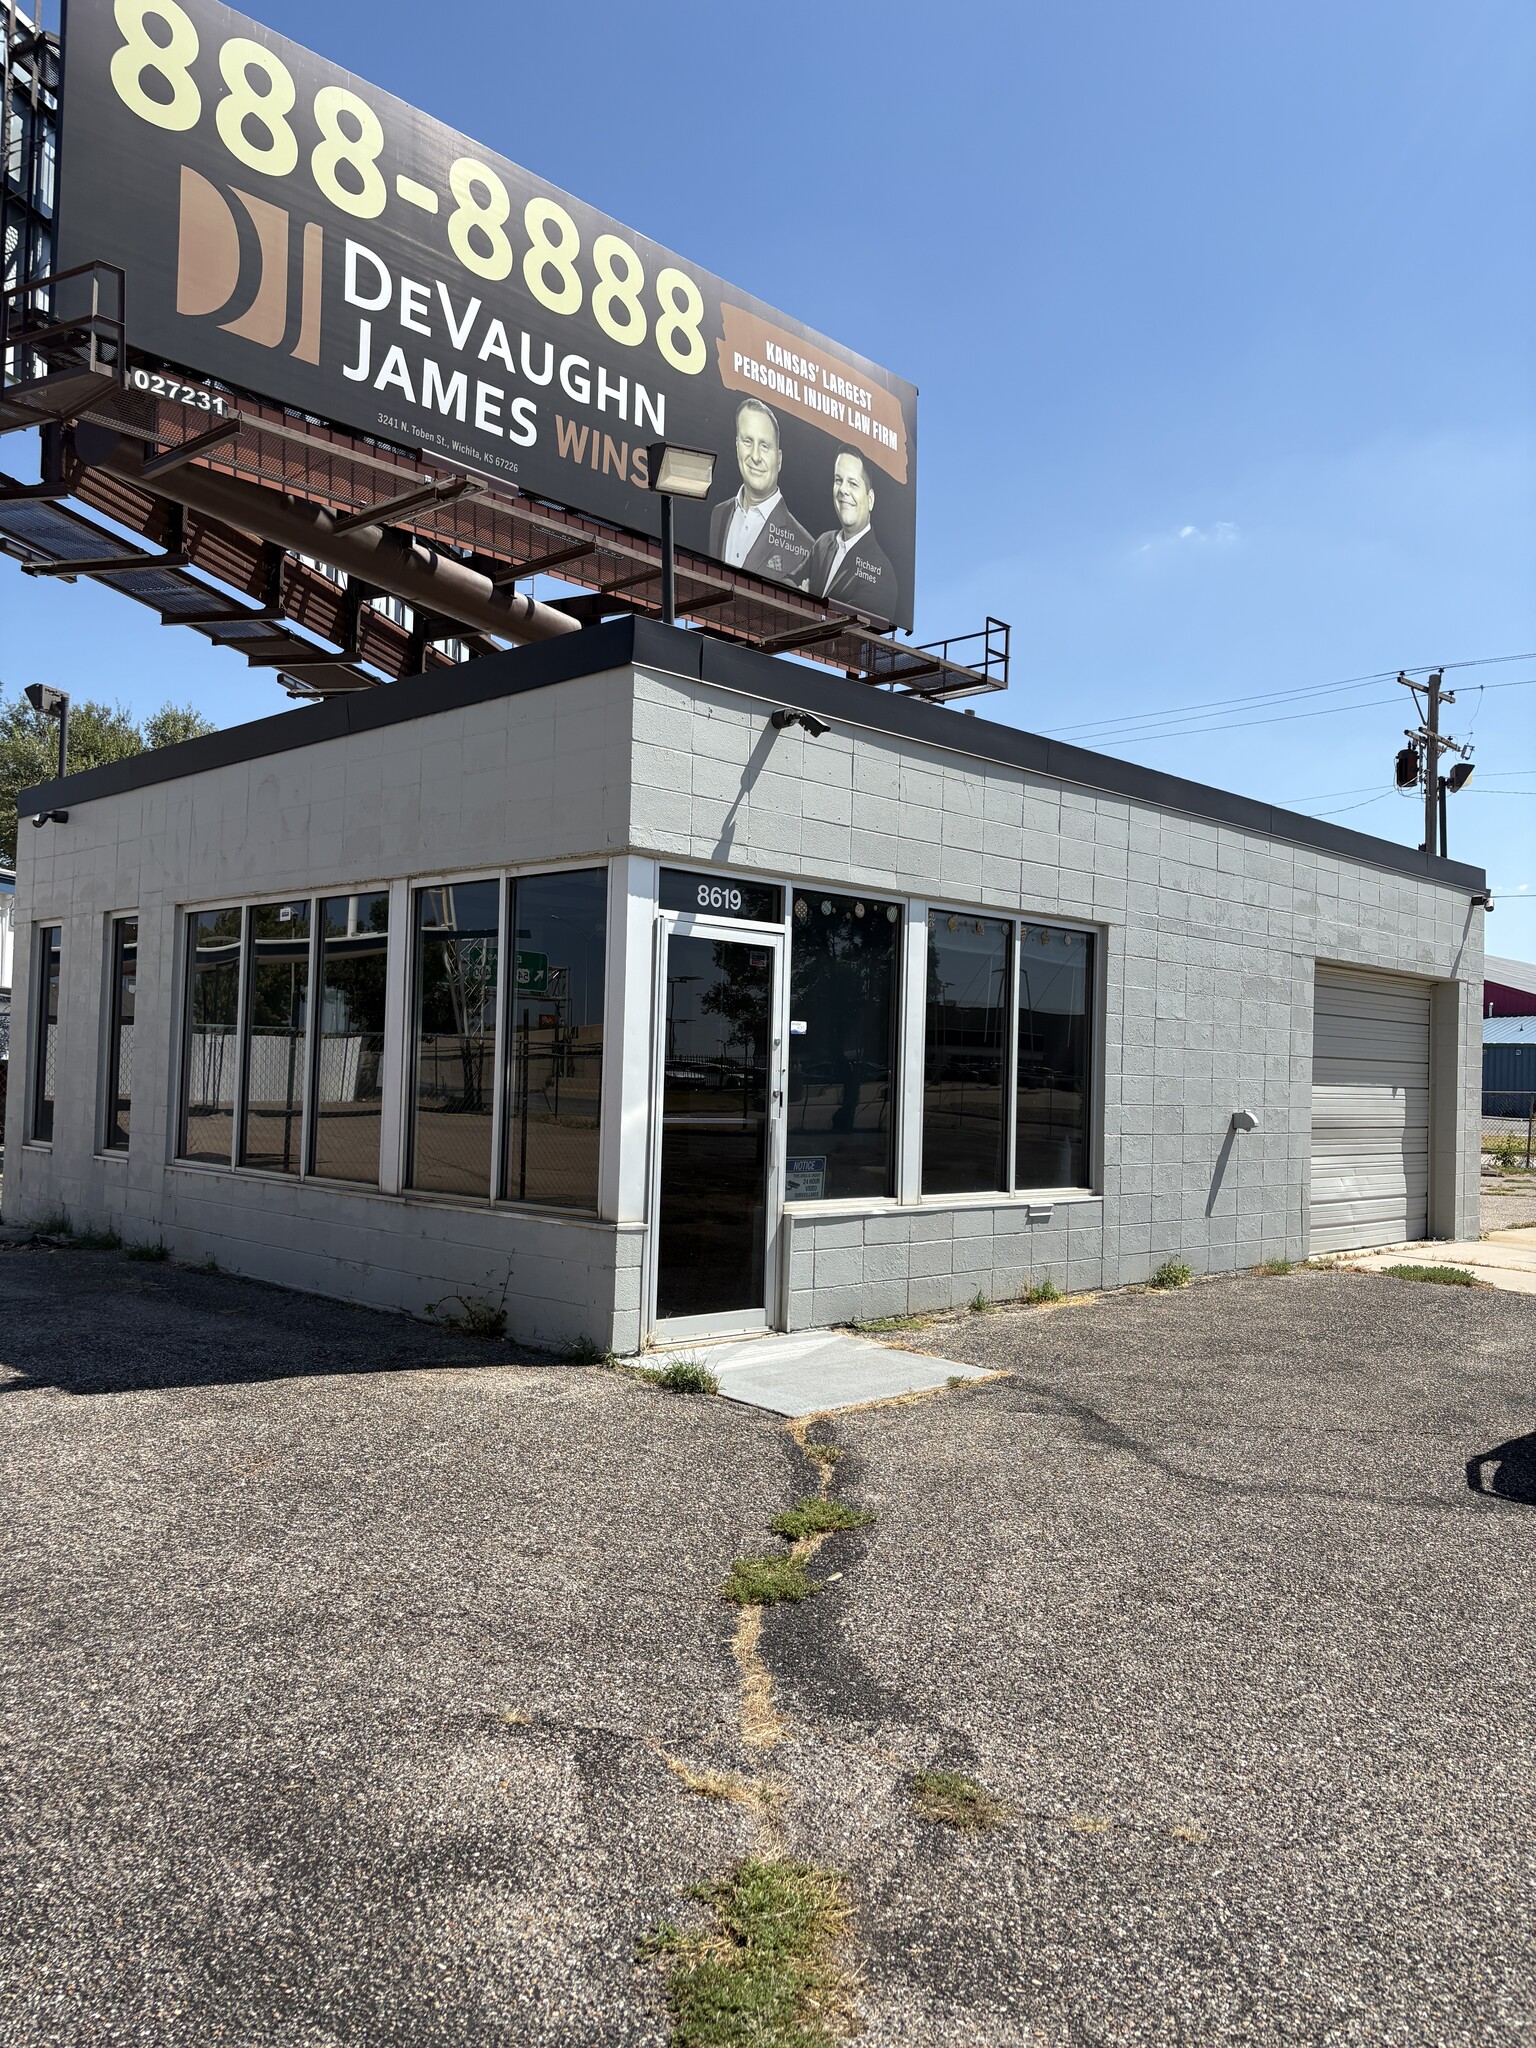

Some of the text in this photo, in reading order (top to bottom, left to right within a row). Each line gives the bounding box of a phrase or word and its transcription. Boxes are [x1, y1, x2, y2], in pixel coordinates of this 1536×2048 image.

[110, 0, 707, 375] 888-8888
[134, 369, 223, 416] 027231
[765, 340, 872, 412] KANSAS' LARGEST
[342, 318, 650, 489] JAMES WINS
[733, 352, 898, 451] PERSONAL INJURY LAW FIRM
[377, 412, 399, 430] 3241
[400, 421, 410, 433] N.
[411, 425, 435, 442] Toben
[451, 440, 482, 461] Wichita,
[483, 452, 494, 464] KS
[495, 458, 519, 473] 67226
[768, 534, 810, 557] DeVaughn
[769, 522, 795, 541] Dustin
[854, 567, 877, 584] James
[855, 556, 881, 576] Richard
[697, 884, 742, 910] 8619
[793, 1161, 815, 1170] NOTICE
